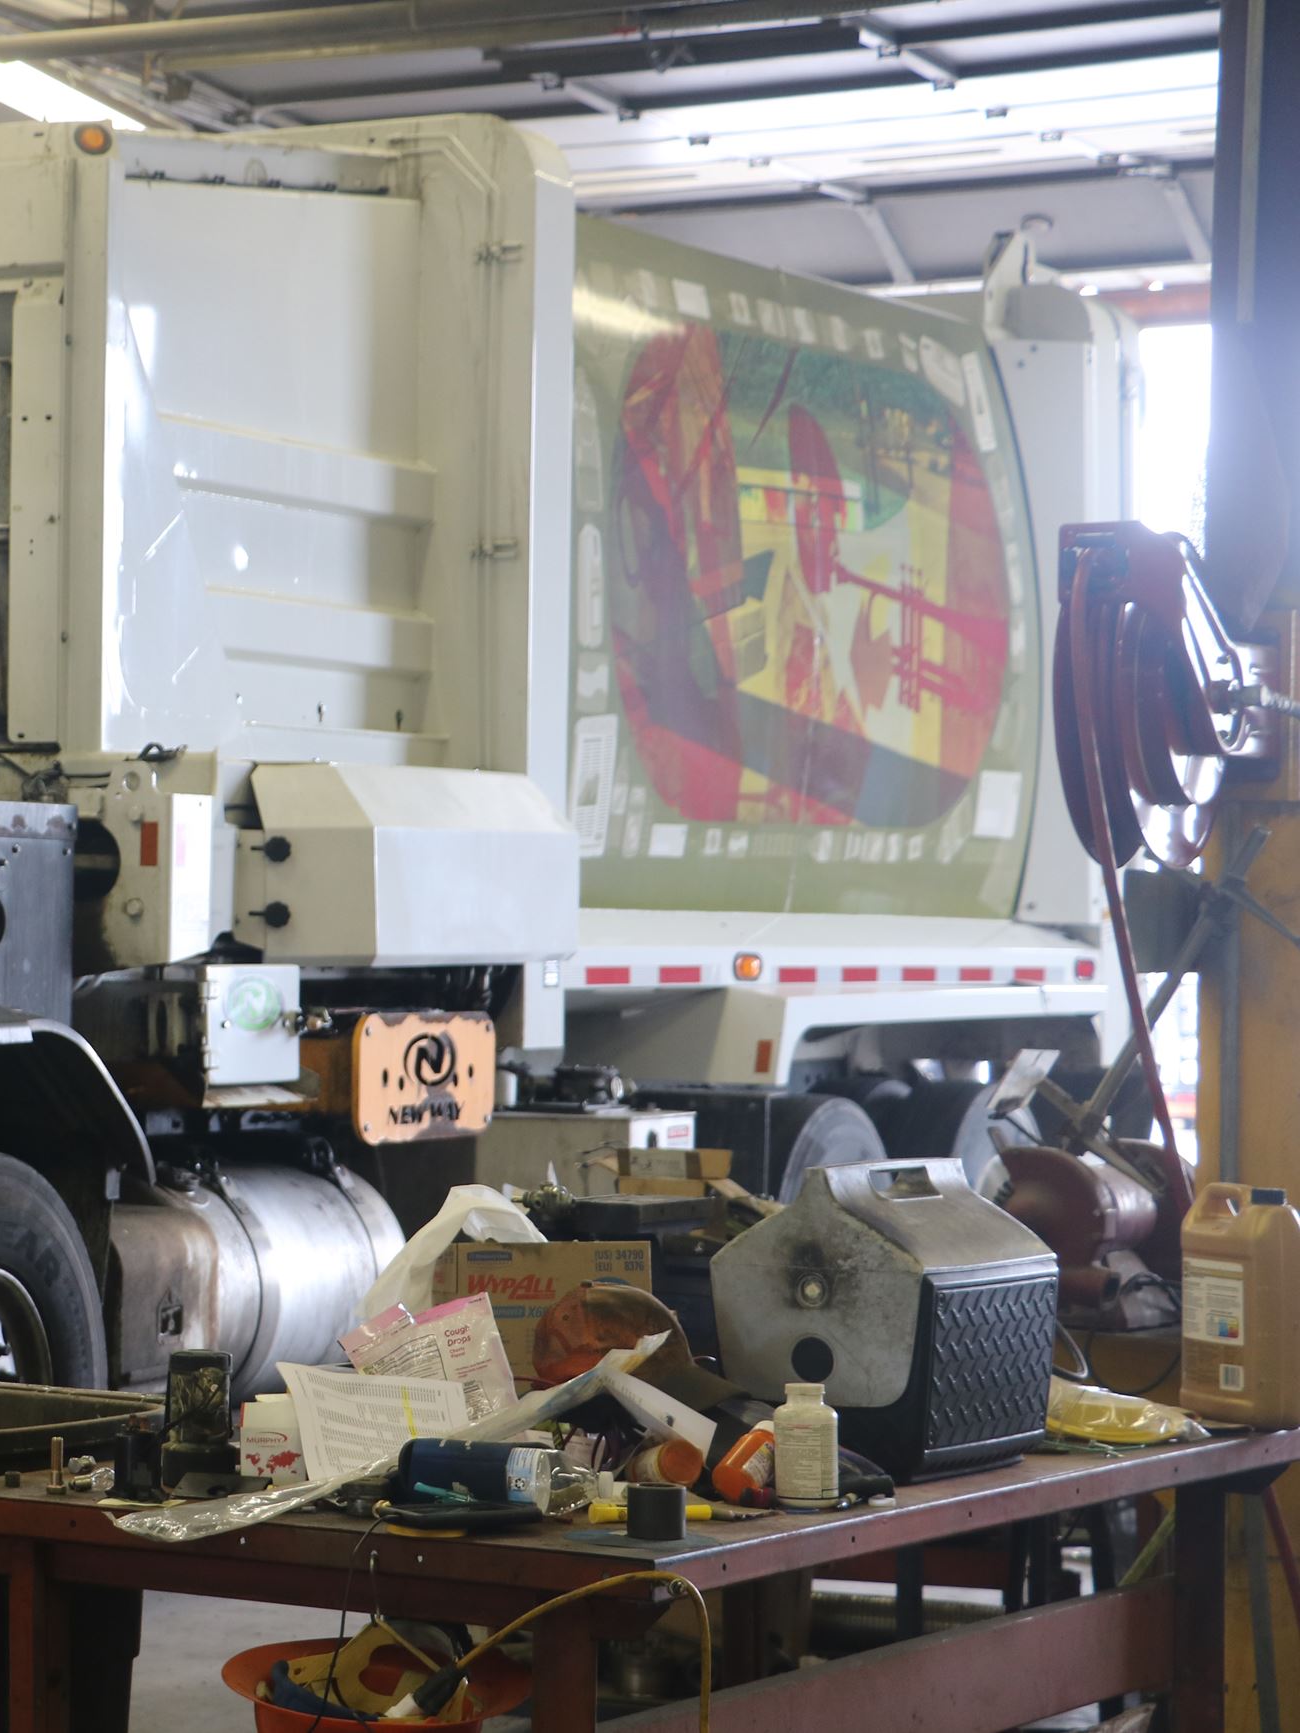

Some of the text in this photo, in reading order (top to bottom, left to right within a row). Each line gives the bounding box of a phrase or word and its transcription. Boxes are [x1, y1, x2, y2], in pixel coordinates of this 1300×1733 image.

[387, 1101, 465, 1125] NEW WAY
[447, 1335, 472, 1347] Drops
[246, 1436, 283, 1444] MURPHY
